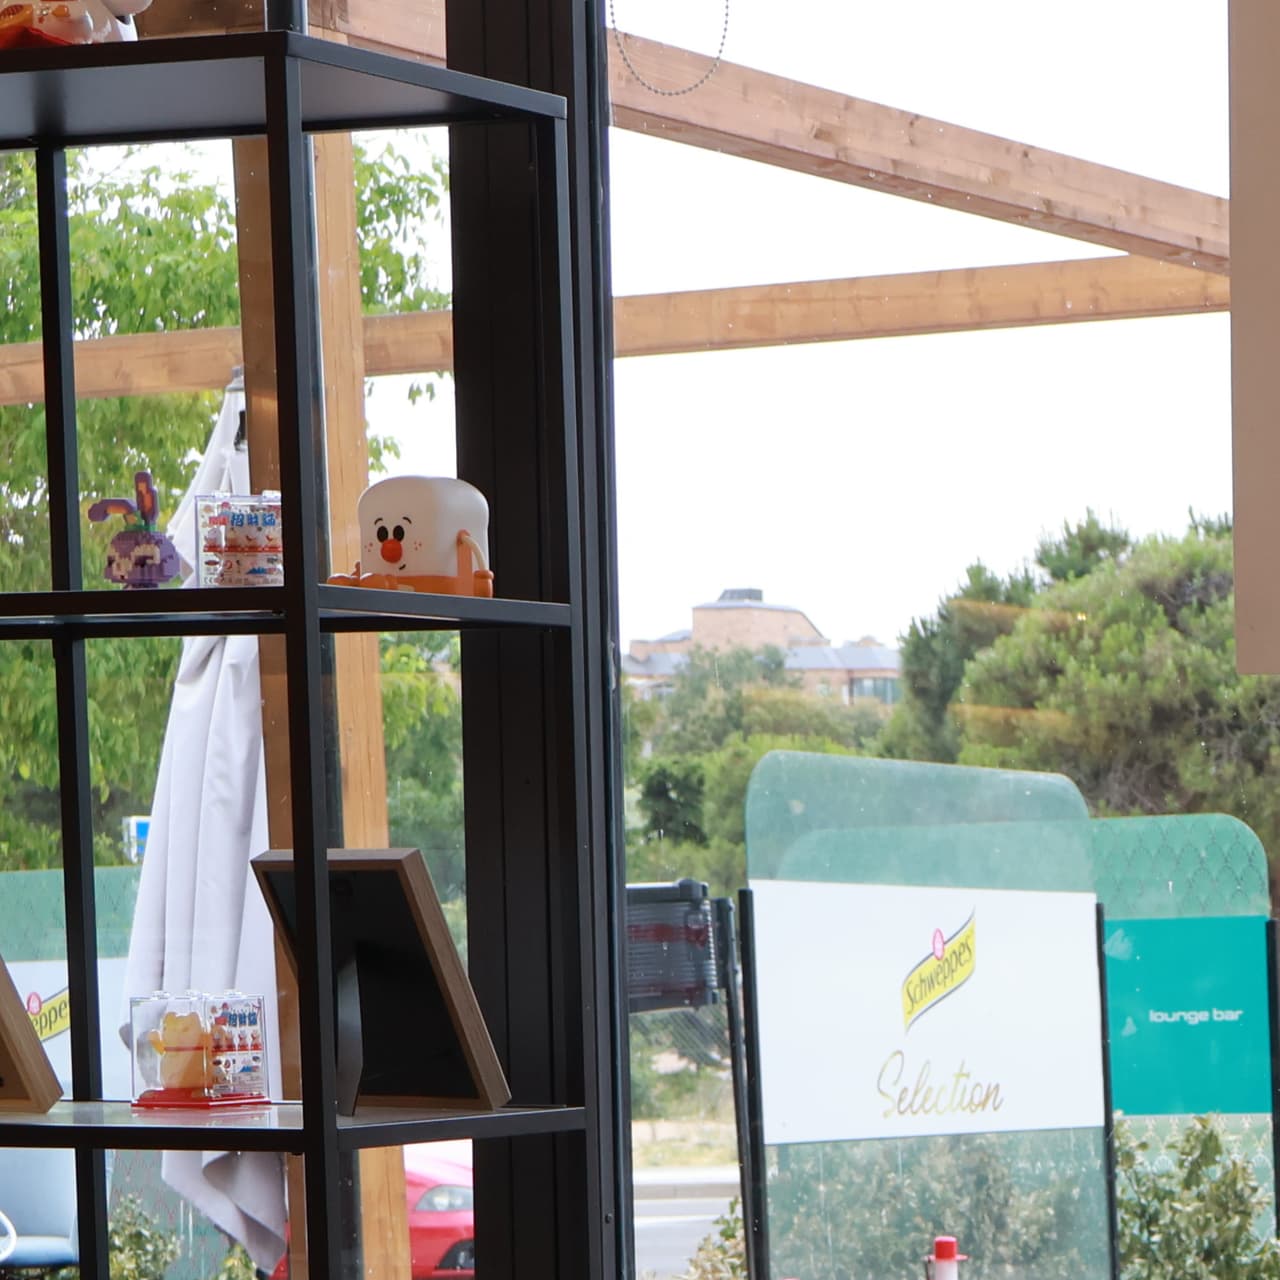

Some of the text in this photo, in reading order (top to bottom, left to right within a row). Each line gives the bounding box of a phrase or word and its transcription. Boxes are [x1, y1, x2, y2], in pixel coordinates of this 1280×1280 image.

[905, 934, 974, 1016] Schweppes
[1149, 1007, 1243, 1025] lounge bar
[876, 1049, 1005, 1120] Selection
